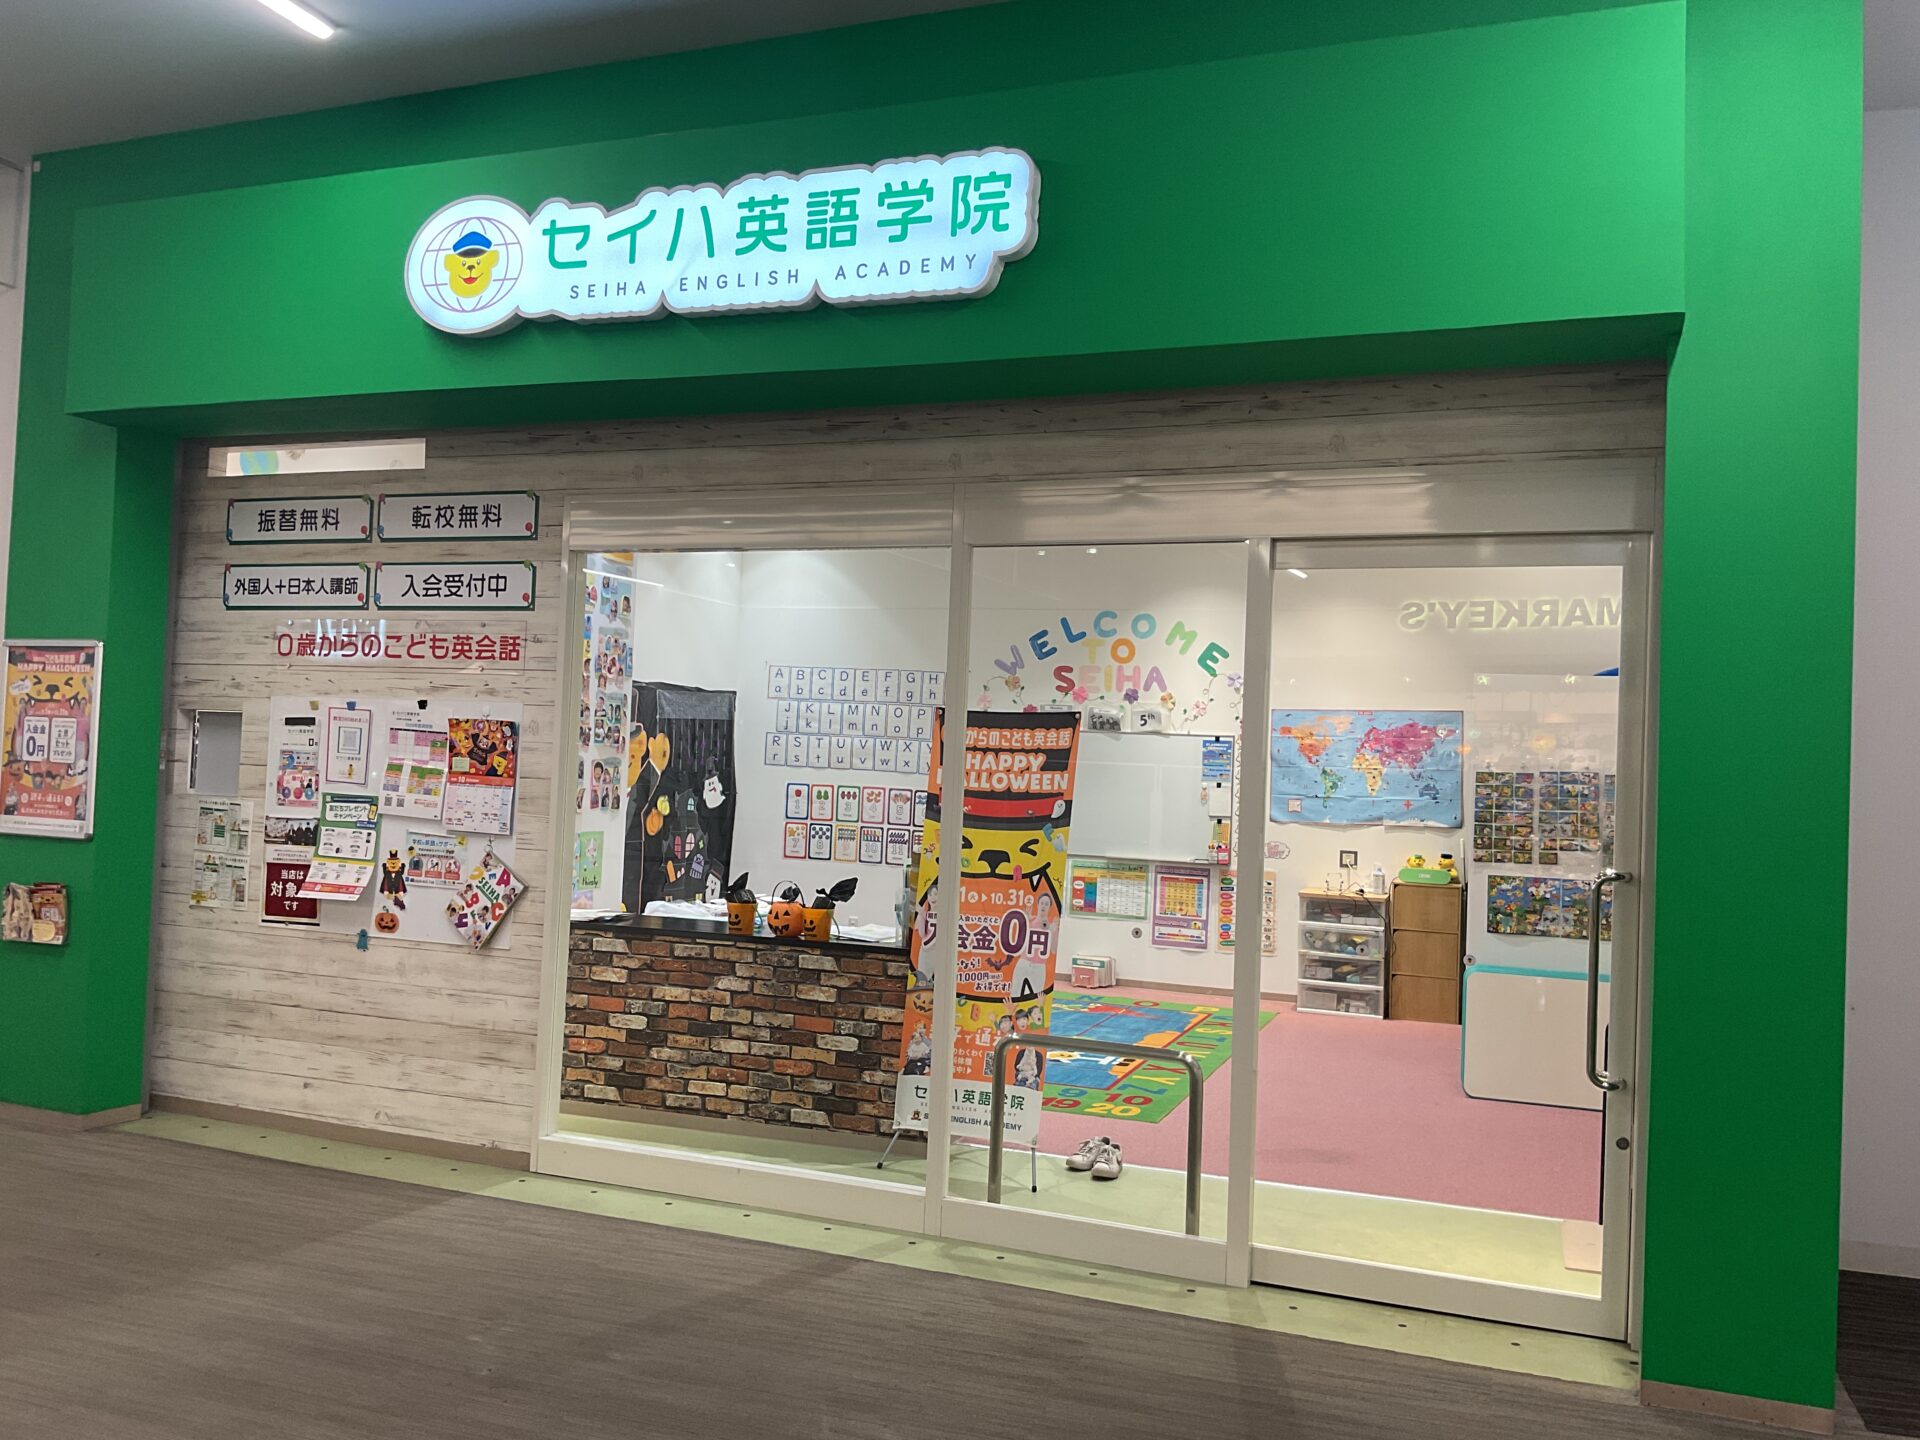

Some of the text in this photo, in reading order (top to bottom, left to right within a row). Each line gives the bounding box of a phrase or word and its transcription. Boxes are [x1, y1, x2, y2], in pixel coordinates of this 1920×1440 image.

[542, 170, 1013, 270] セイハ英語学院
[569, 253, 979, 300] SEIHA ENGLISH ACADEMY
[257, 508, 340, 533] 振替無料
[411, 504, 502, 529] 転校無料
[234, 576, 358, 596] 外国人+日本人講師
[401, 574, 508, 598] 入会受付中
[278, 634, 521, 661] 0歳からのこども英会話
[994, 610, 1230, 678] WELCOME
[1081, 638, 1136, 665] TO
[17, 663, 91, 673] HAPPY HALLOWEEN
[775, 668, 938, 684] A B C D E F G H
[1053, 664, 1168, 694] SEIHA
[796, 685, 803, 695] b
[840, 686, 846, 696] d
[884, 686, 890, 696] f
[906, 691, 913, 701] g
[929, 689, 936, 699] h
[785, 703, 926, 719] J K L M N O P
[1139, 713, 1156, 727] 5th
[784, 716, 789, 730] j
[806, 718, 811, 728] k
[917, 727, 923, 738] p
[26, 736, 45, 757] 0円
[773, 736, 780, 746] R
[794, 737, 801, 747] S
[816, 738, 823, 748] T
[837, 738, 845, 749] U
[860, 739, 868, 750] V
[880, 741, 892, 751] W
[903, 742, 912, 752] X
[965, 730, 1072, 746] からのこども英会話
[816, 755, 821, 763] t
[966, 753, 1043, 771] HAPPY
[937, 768, 1069, 790] LLOWEEN
[281, 869, 304, 880] 当店は
[478, 877, 501, 901] SEIHA
[283, 901, 299, 911] です
[915, 1085, 1025, 1111] セ英語院
[1058, 1088, 1153, 1105] 9 10
[1084, 1102, 1141, 1116] 20
[983, 1119, 1022, 1131] ADEMY
